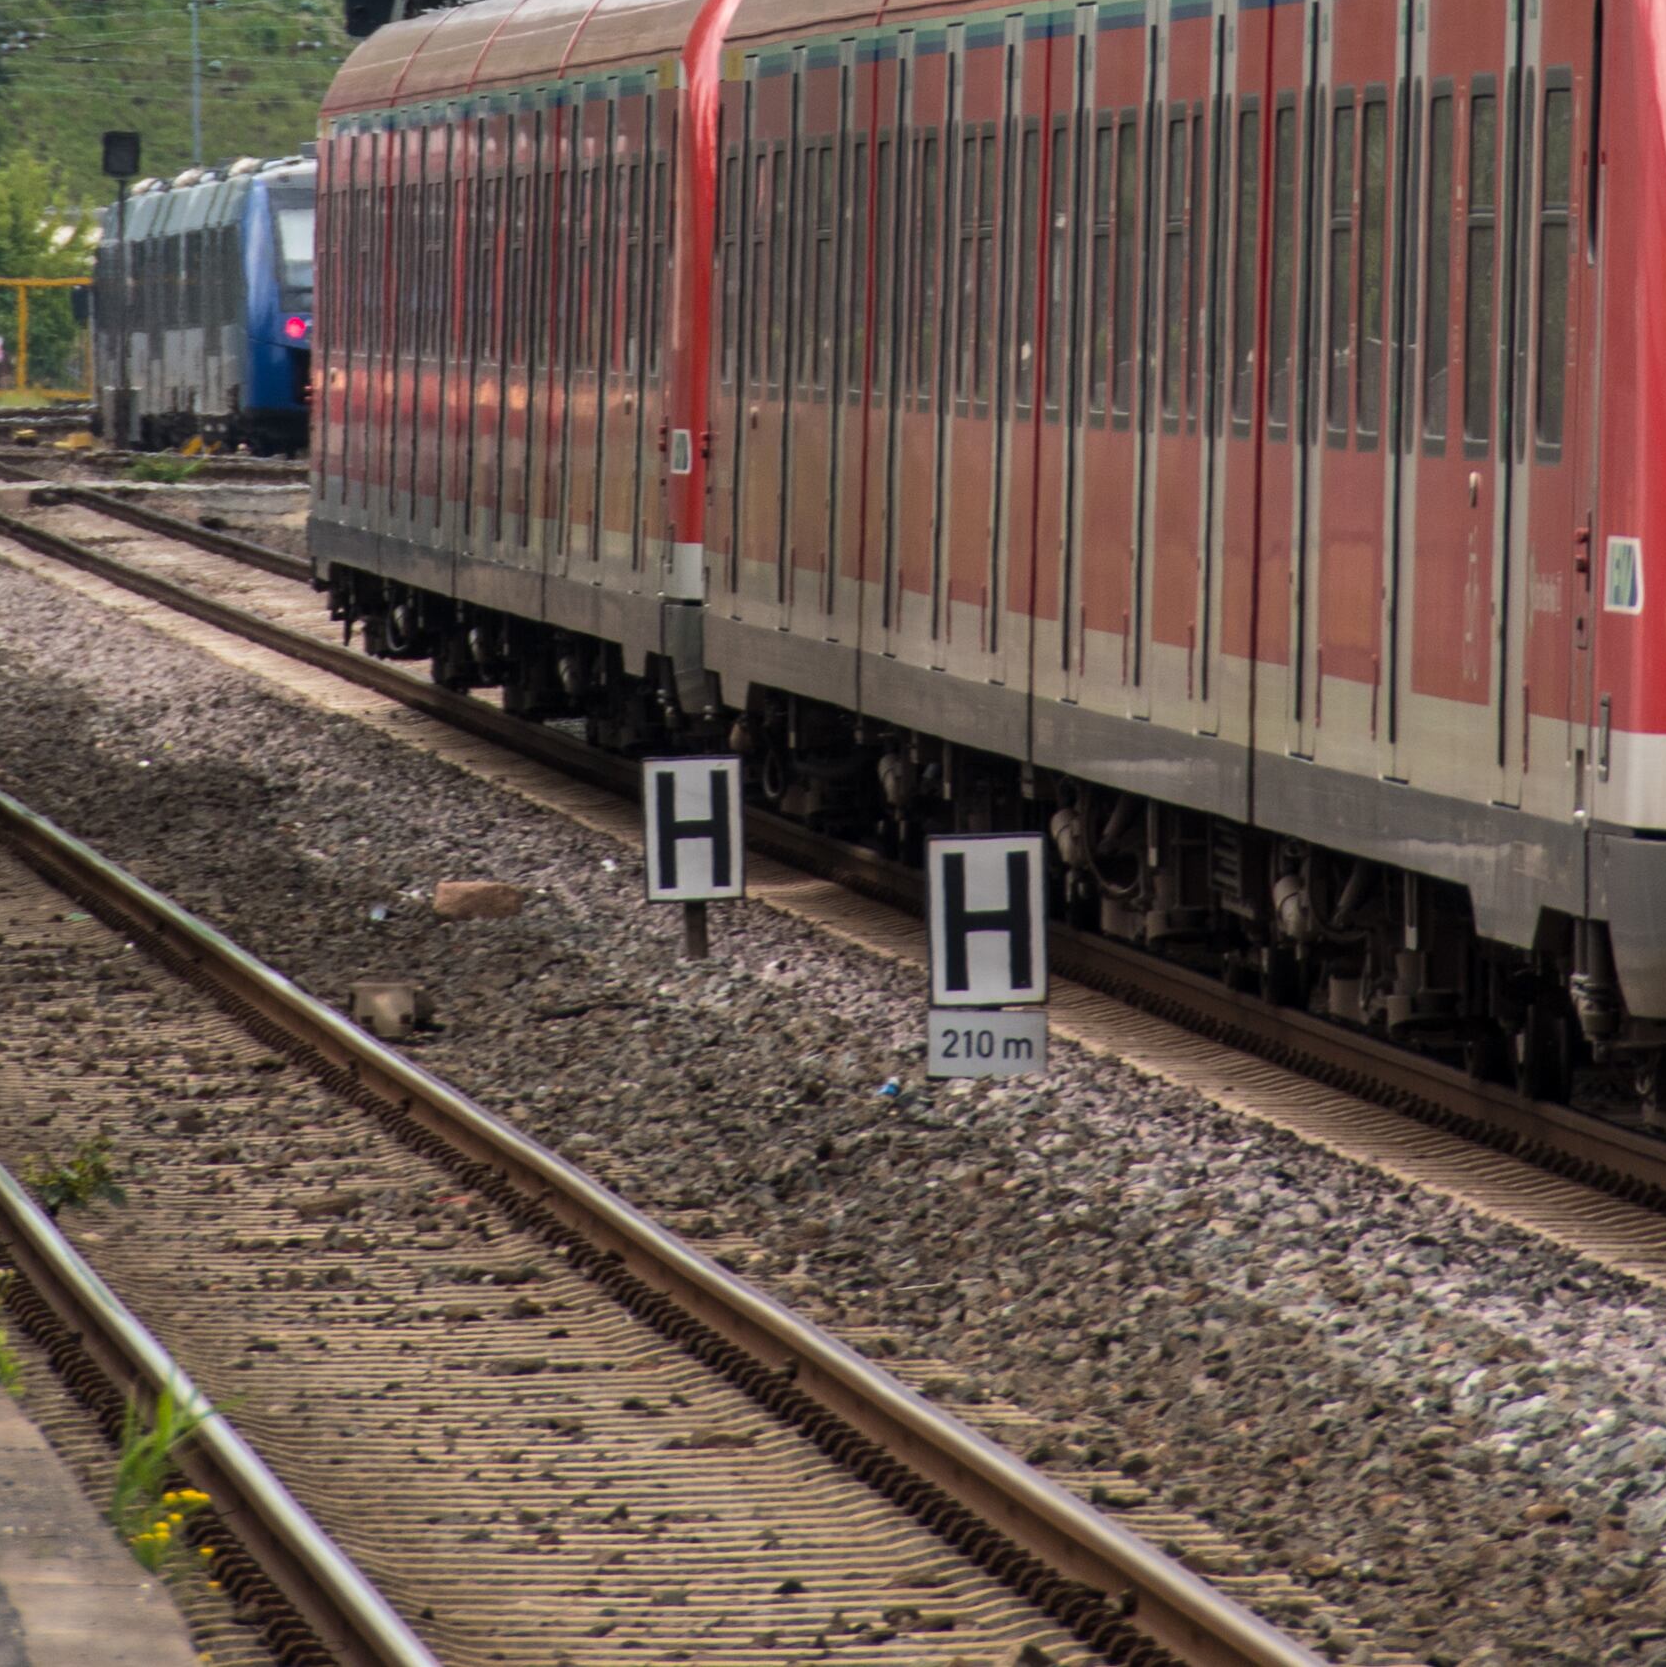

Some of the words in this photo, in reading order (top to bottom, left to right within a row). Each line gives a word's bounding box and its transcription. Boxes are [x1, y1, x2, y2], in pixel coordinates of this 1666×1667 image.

[656, 770, 731, 889] H
[942, 850, 1032, 991] H
[941, 1030, 994, 1060] 210
[1003, 1038, 1033, 1060] m
